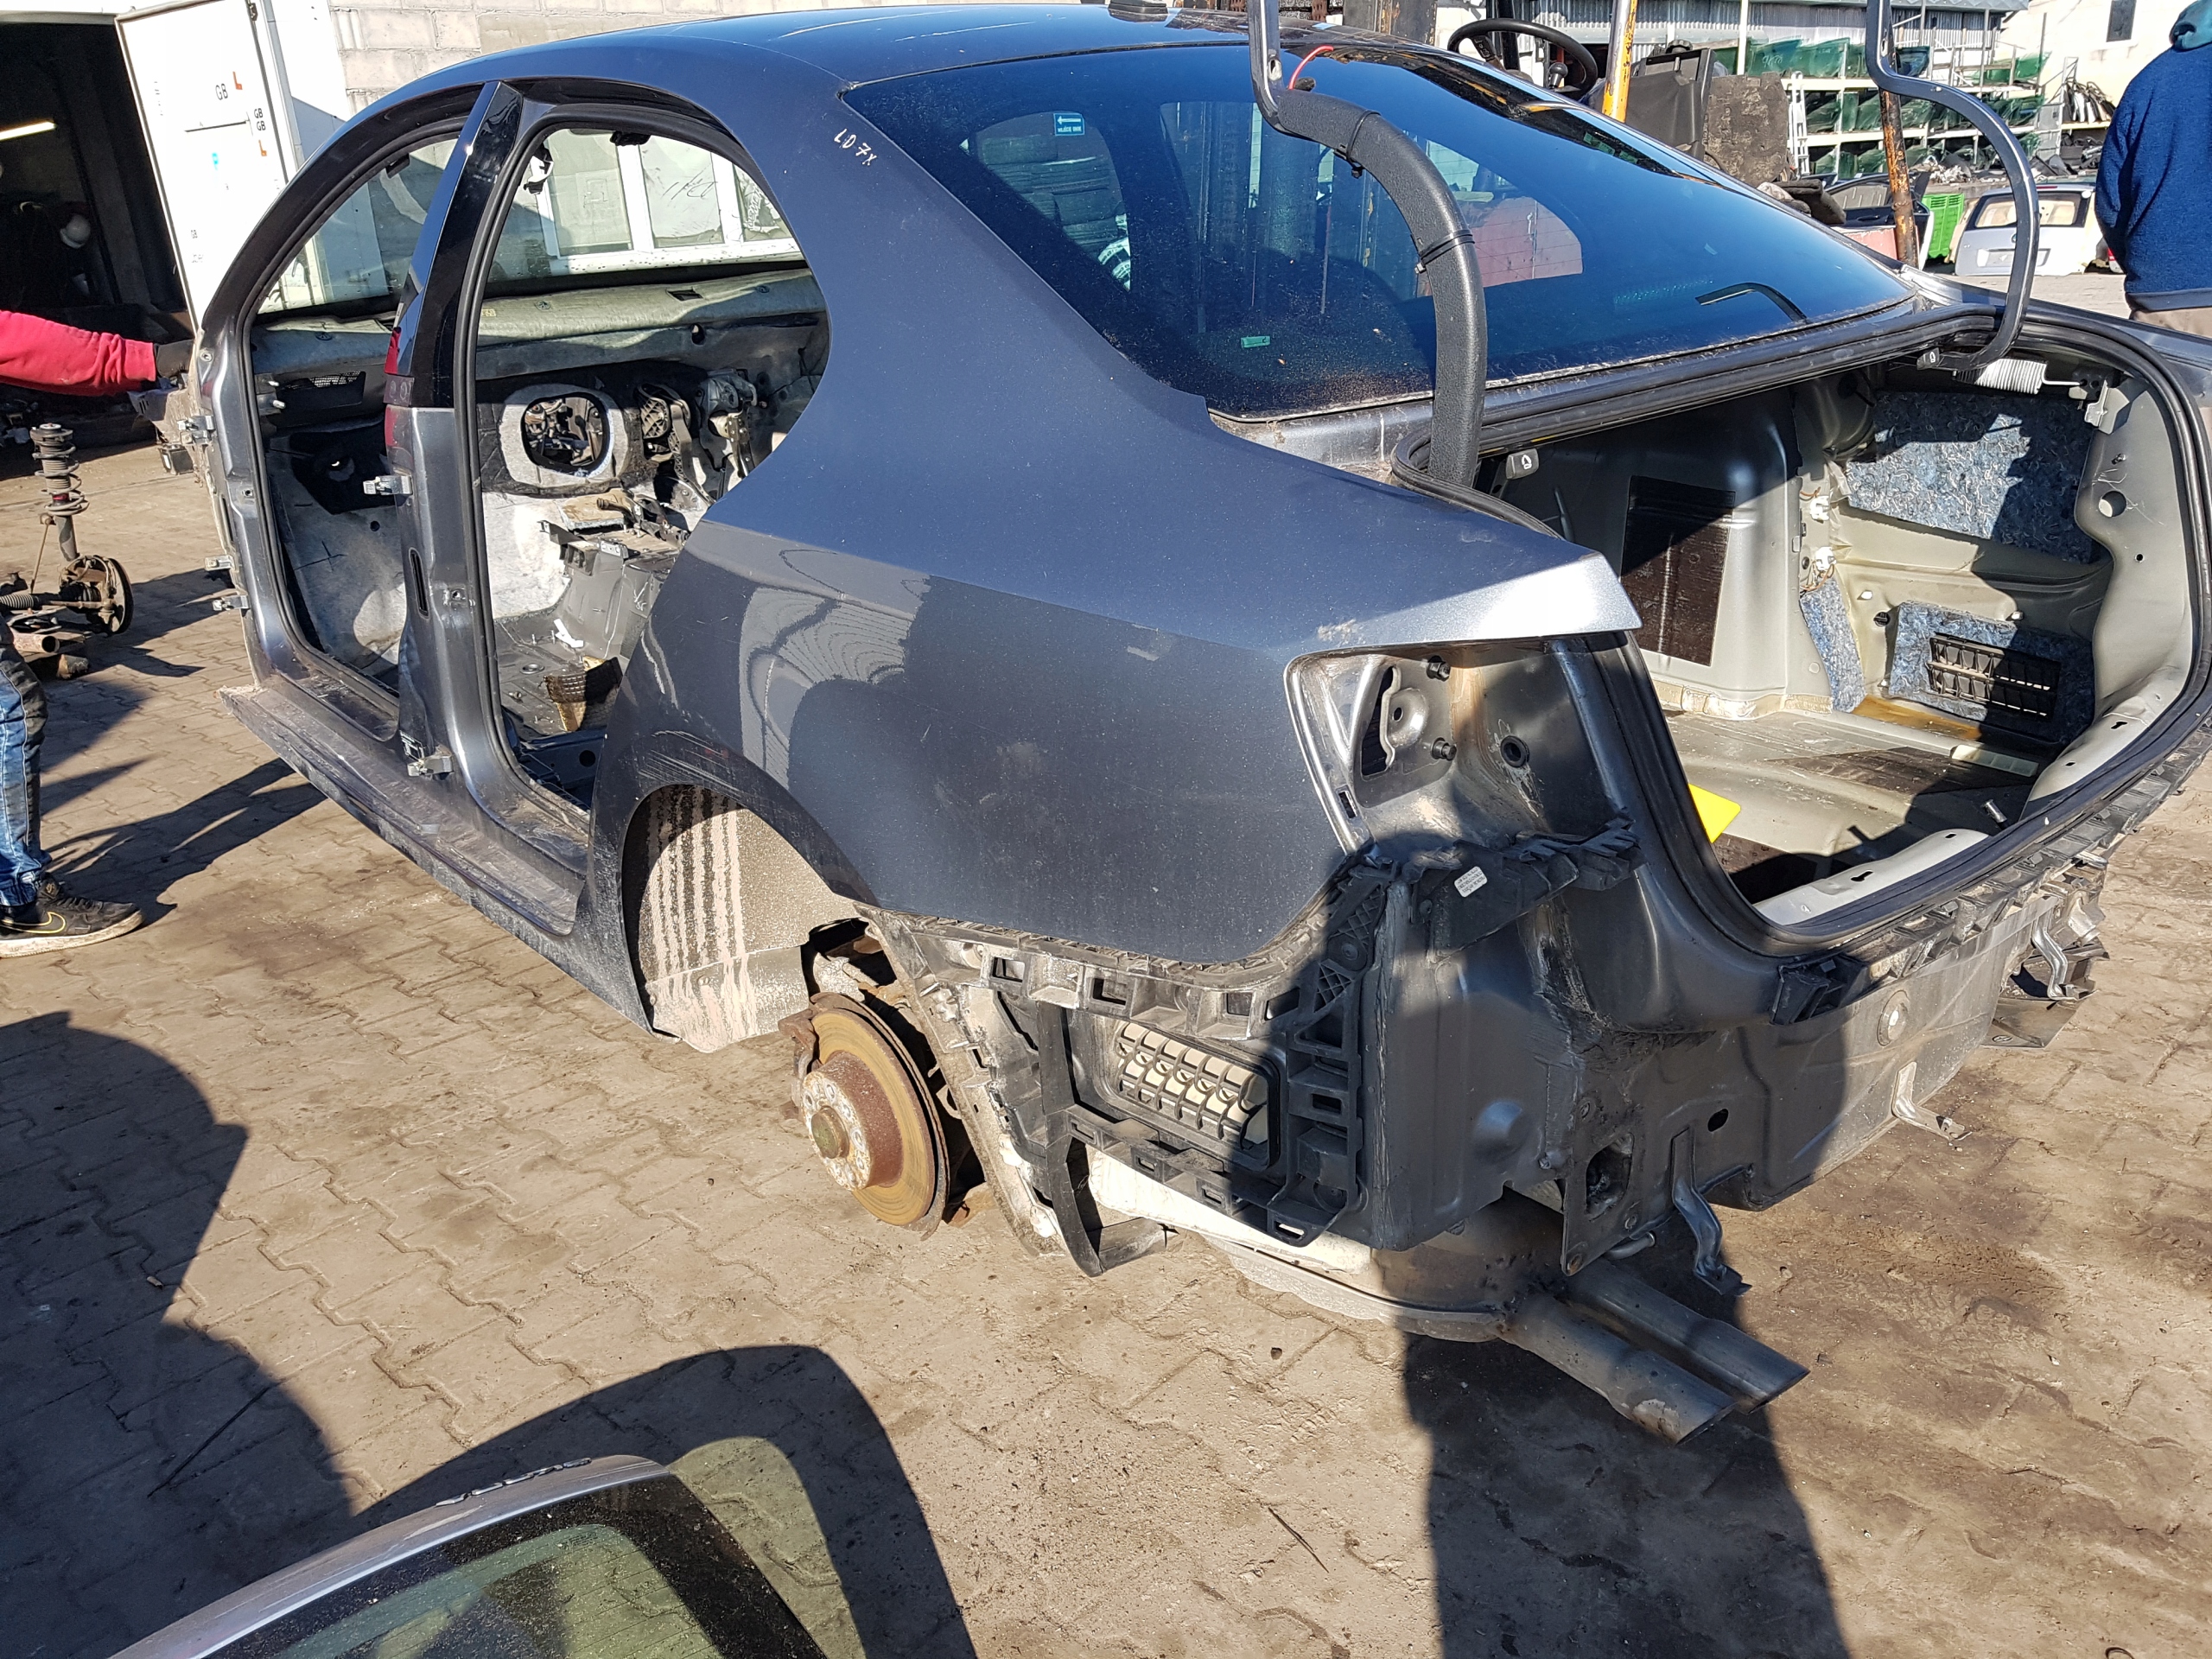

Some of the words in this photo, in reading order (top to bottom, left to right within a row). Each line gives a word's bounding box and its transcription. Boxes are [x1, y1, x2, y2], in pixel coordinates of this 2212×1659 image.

[215, 83, 228, 101] GB
[254, 108, 264, 119] GB
[256, 120, 266, 131] GB
